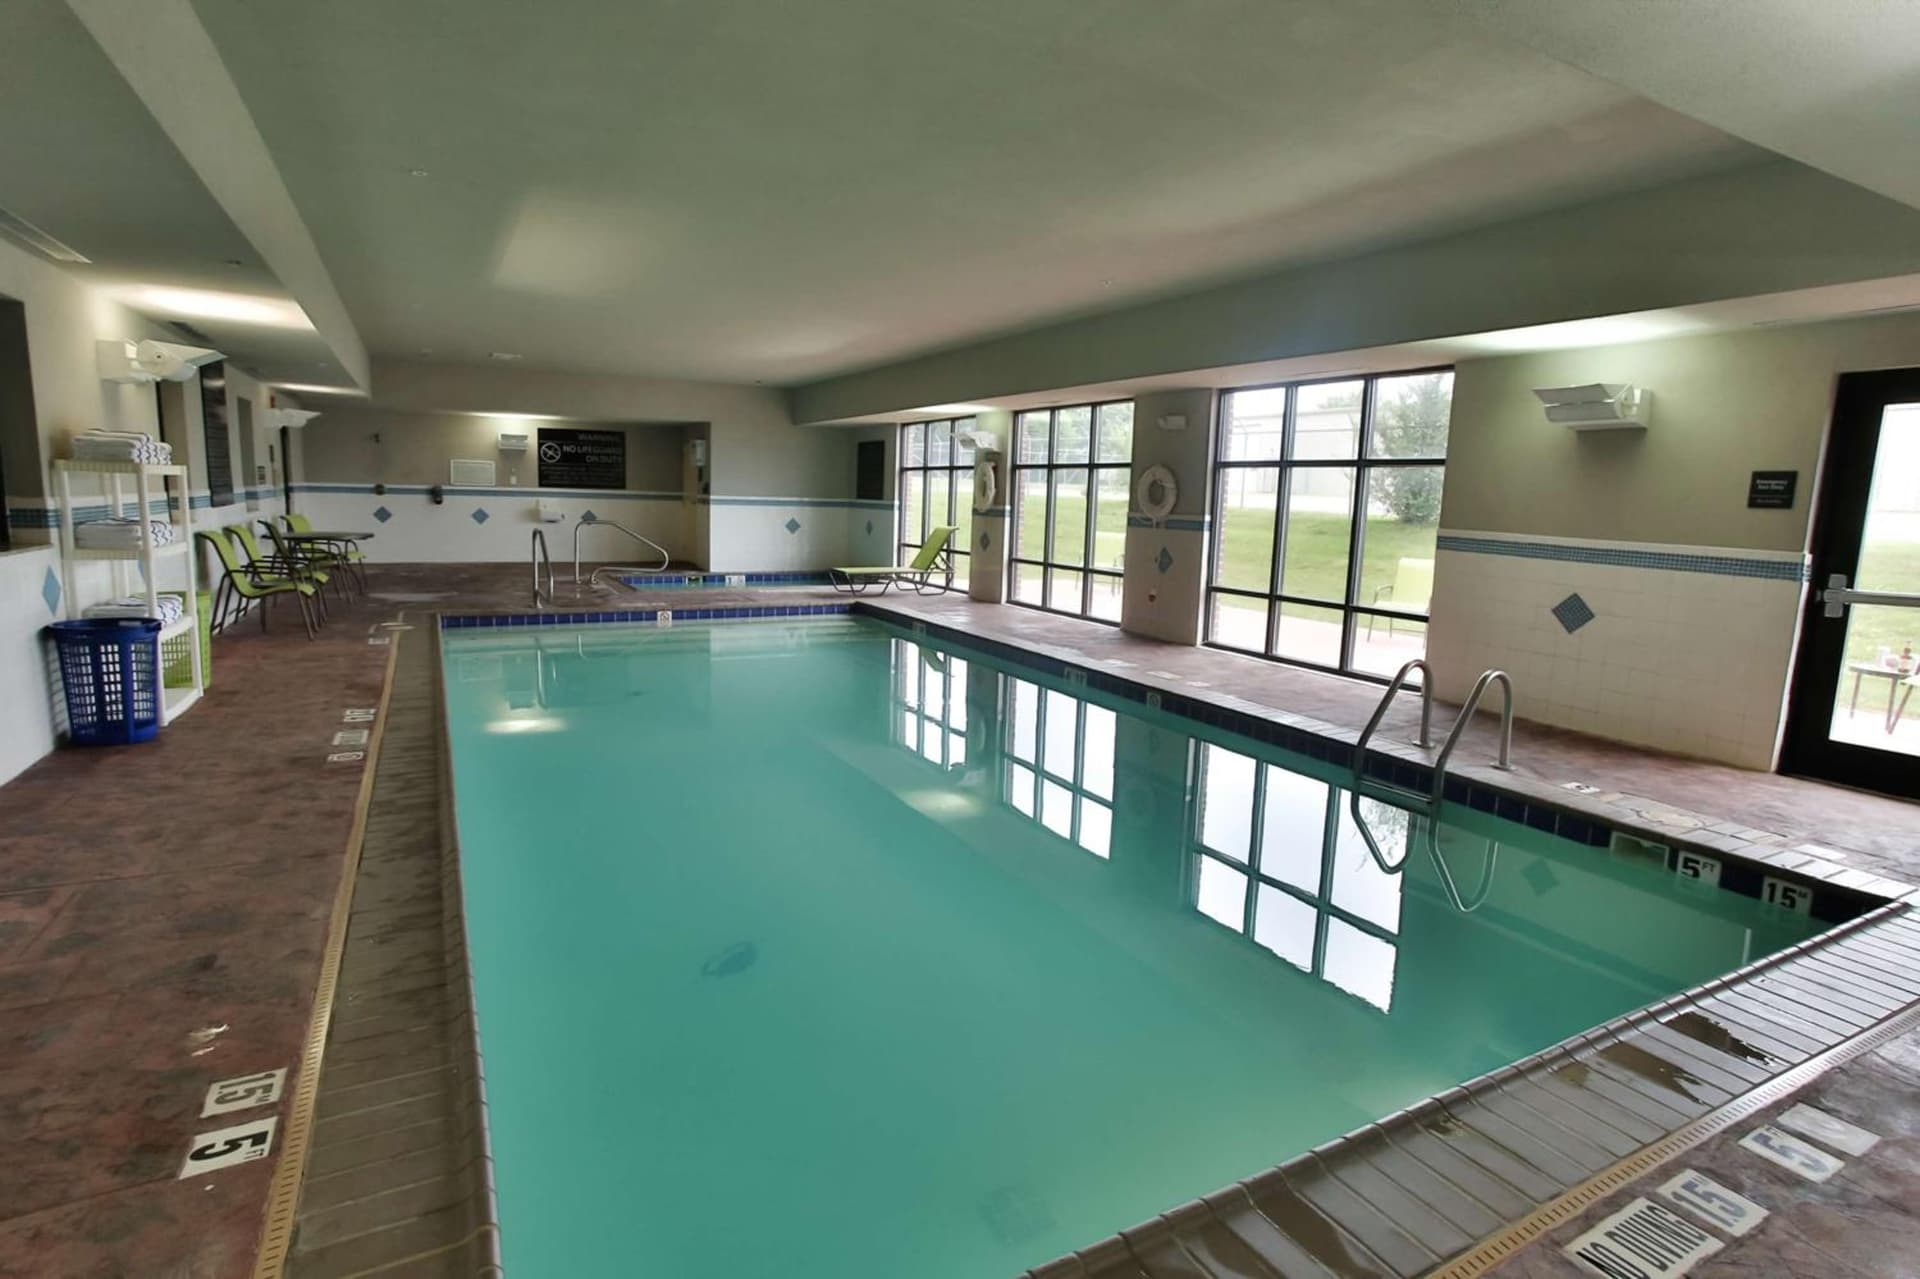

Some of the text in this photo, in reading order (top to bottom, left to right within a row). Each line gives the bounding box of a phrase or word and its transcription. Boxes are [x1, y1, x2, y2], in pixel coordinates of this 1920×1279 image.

[1682, 856, 1716, 878] 5 FT
[189, 1130, 270, 1162] 5
[1752, 1132, 1831, 1173] 5
[1575, 1204, 1709, 1279] NO DIVING
